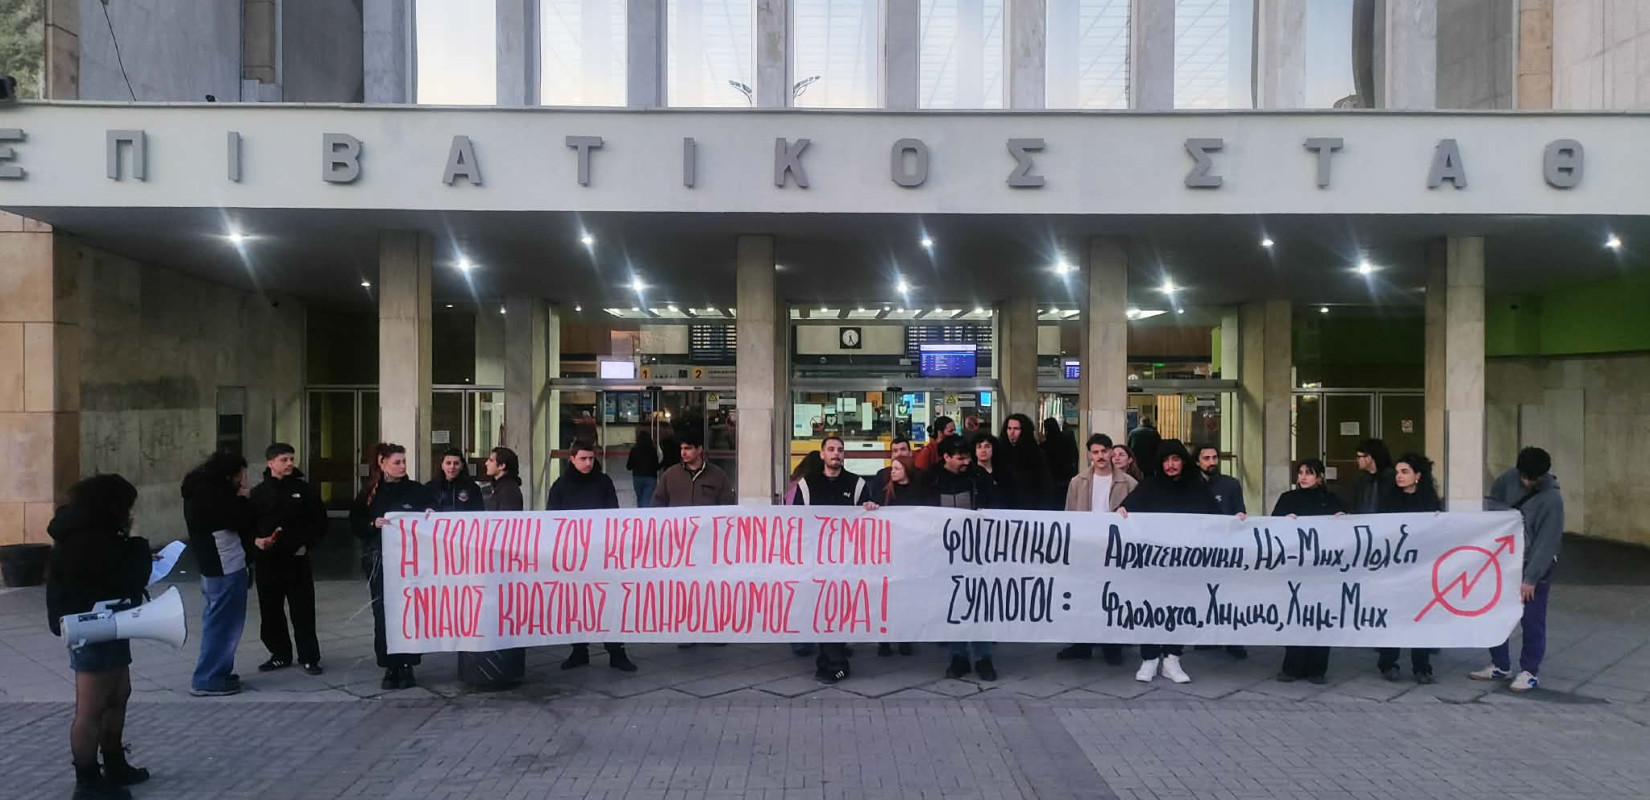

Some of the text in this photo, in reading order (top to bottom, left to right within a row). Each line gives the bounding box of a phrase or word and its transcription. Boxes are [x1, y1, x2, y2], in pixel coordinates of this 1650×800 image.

[1184, 137, 1584, 190] ΣΤΑΘ
[399, 515, 892, 578] Η ΠΟΛΙΤΙΚΗ ΤΟΥ ΚΕΡΔΟΥΣ ΓΕΝΝΑΕΙ ΤΕΜΠΗ
[943, 518, 1070, 565] ΦΟΙΤΗΤΙΚΟΙ
[402, 585, 486, 640] ΕΝΙΑΙΟΣ
[498, 580, 609, 637] ΚΡΑΤΙΚΟΣ
[620, 579, 799, 634] ΣΙΔΗΡΟΔΡΟΜΟΣ
